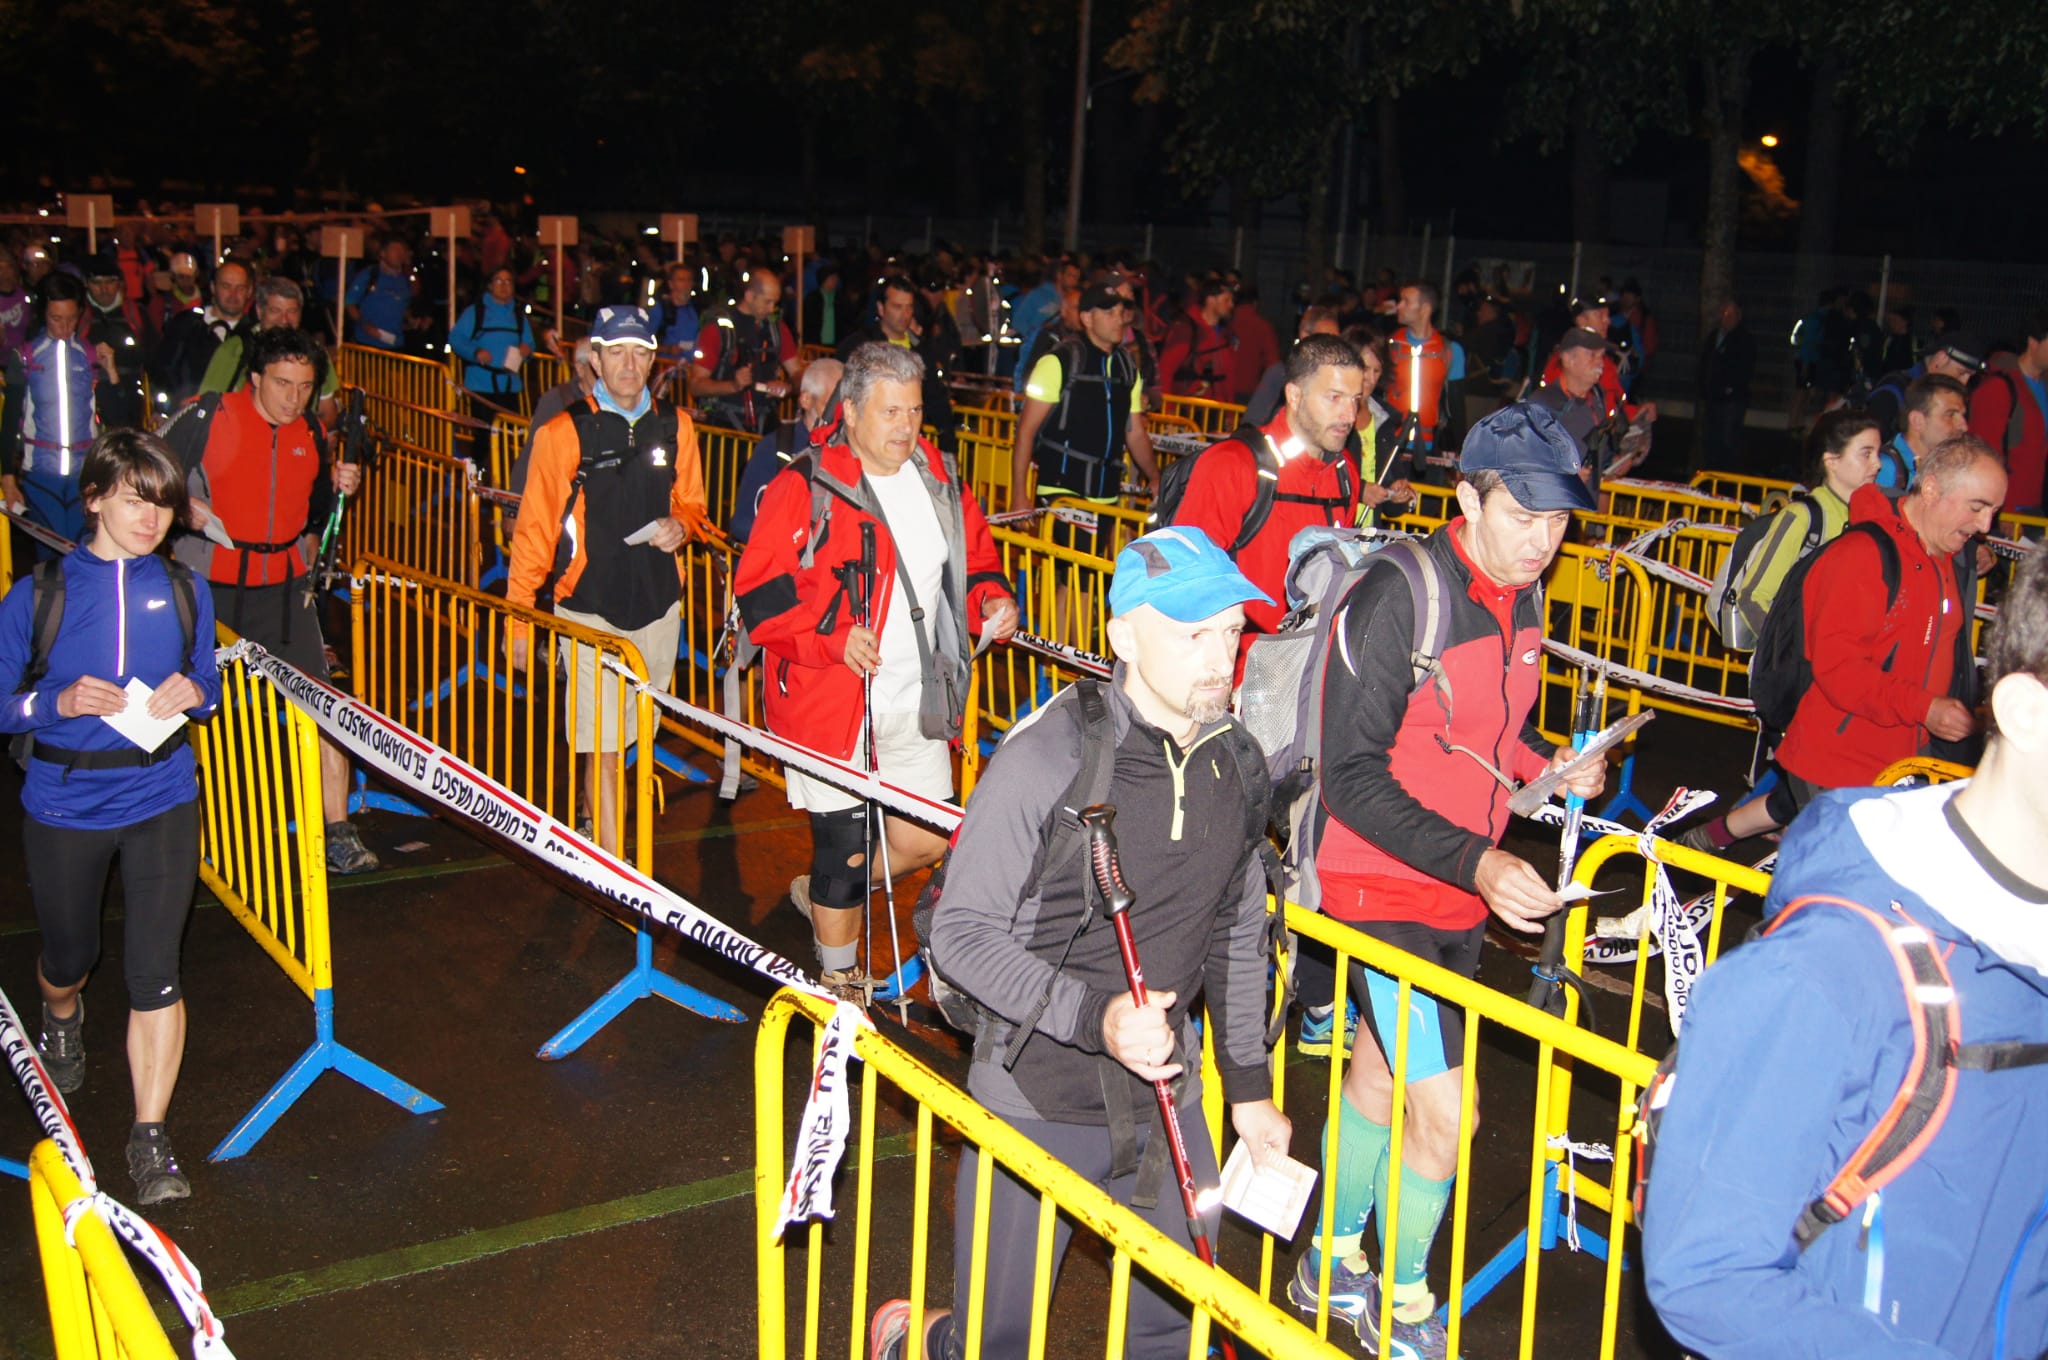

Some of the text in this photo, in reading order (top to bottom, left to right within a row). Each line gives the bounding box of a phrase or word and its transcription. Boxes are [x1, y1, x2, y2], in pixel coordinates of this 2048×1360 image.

[323, 694, 337, 719] EL
[337, 707, 372, 746] VASCO
[372, 728, 412, 772] DIARIO
[414, 752, 428, 780] EL
[432, 767, 473, 810] VASCO
